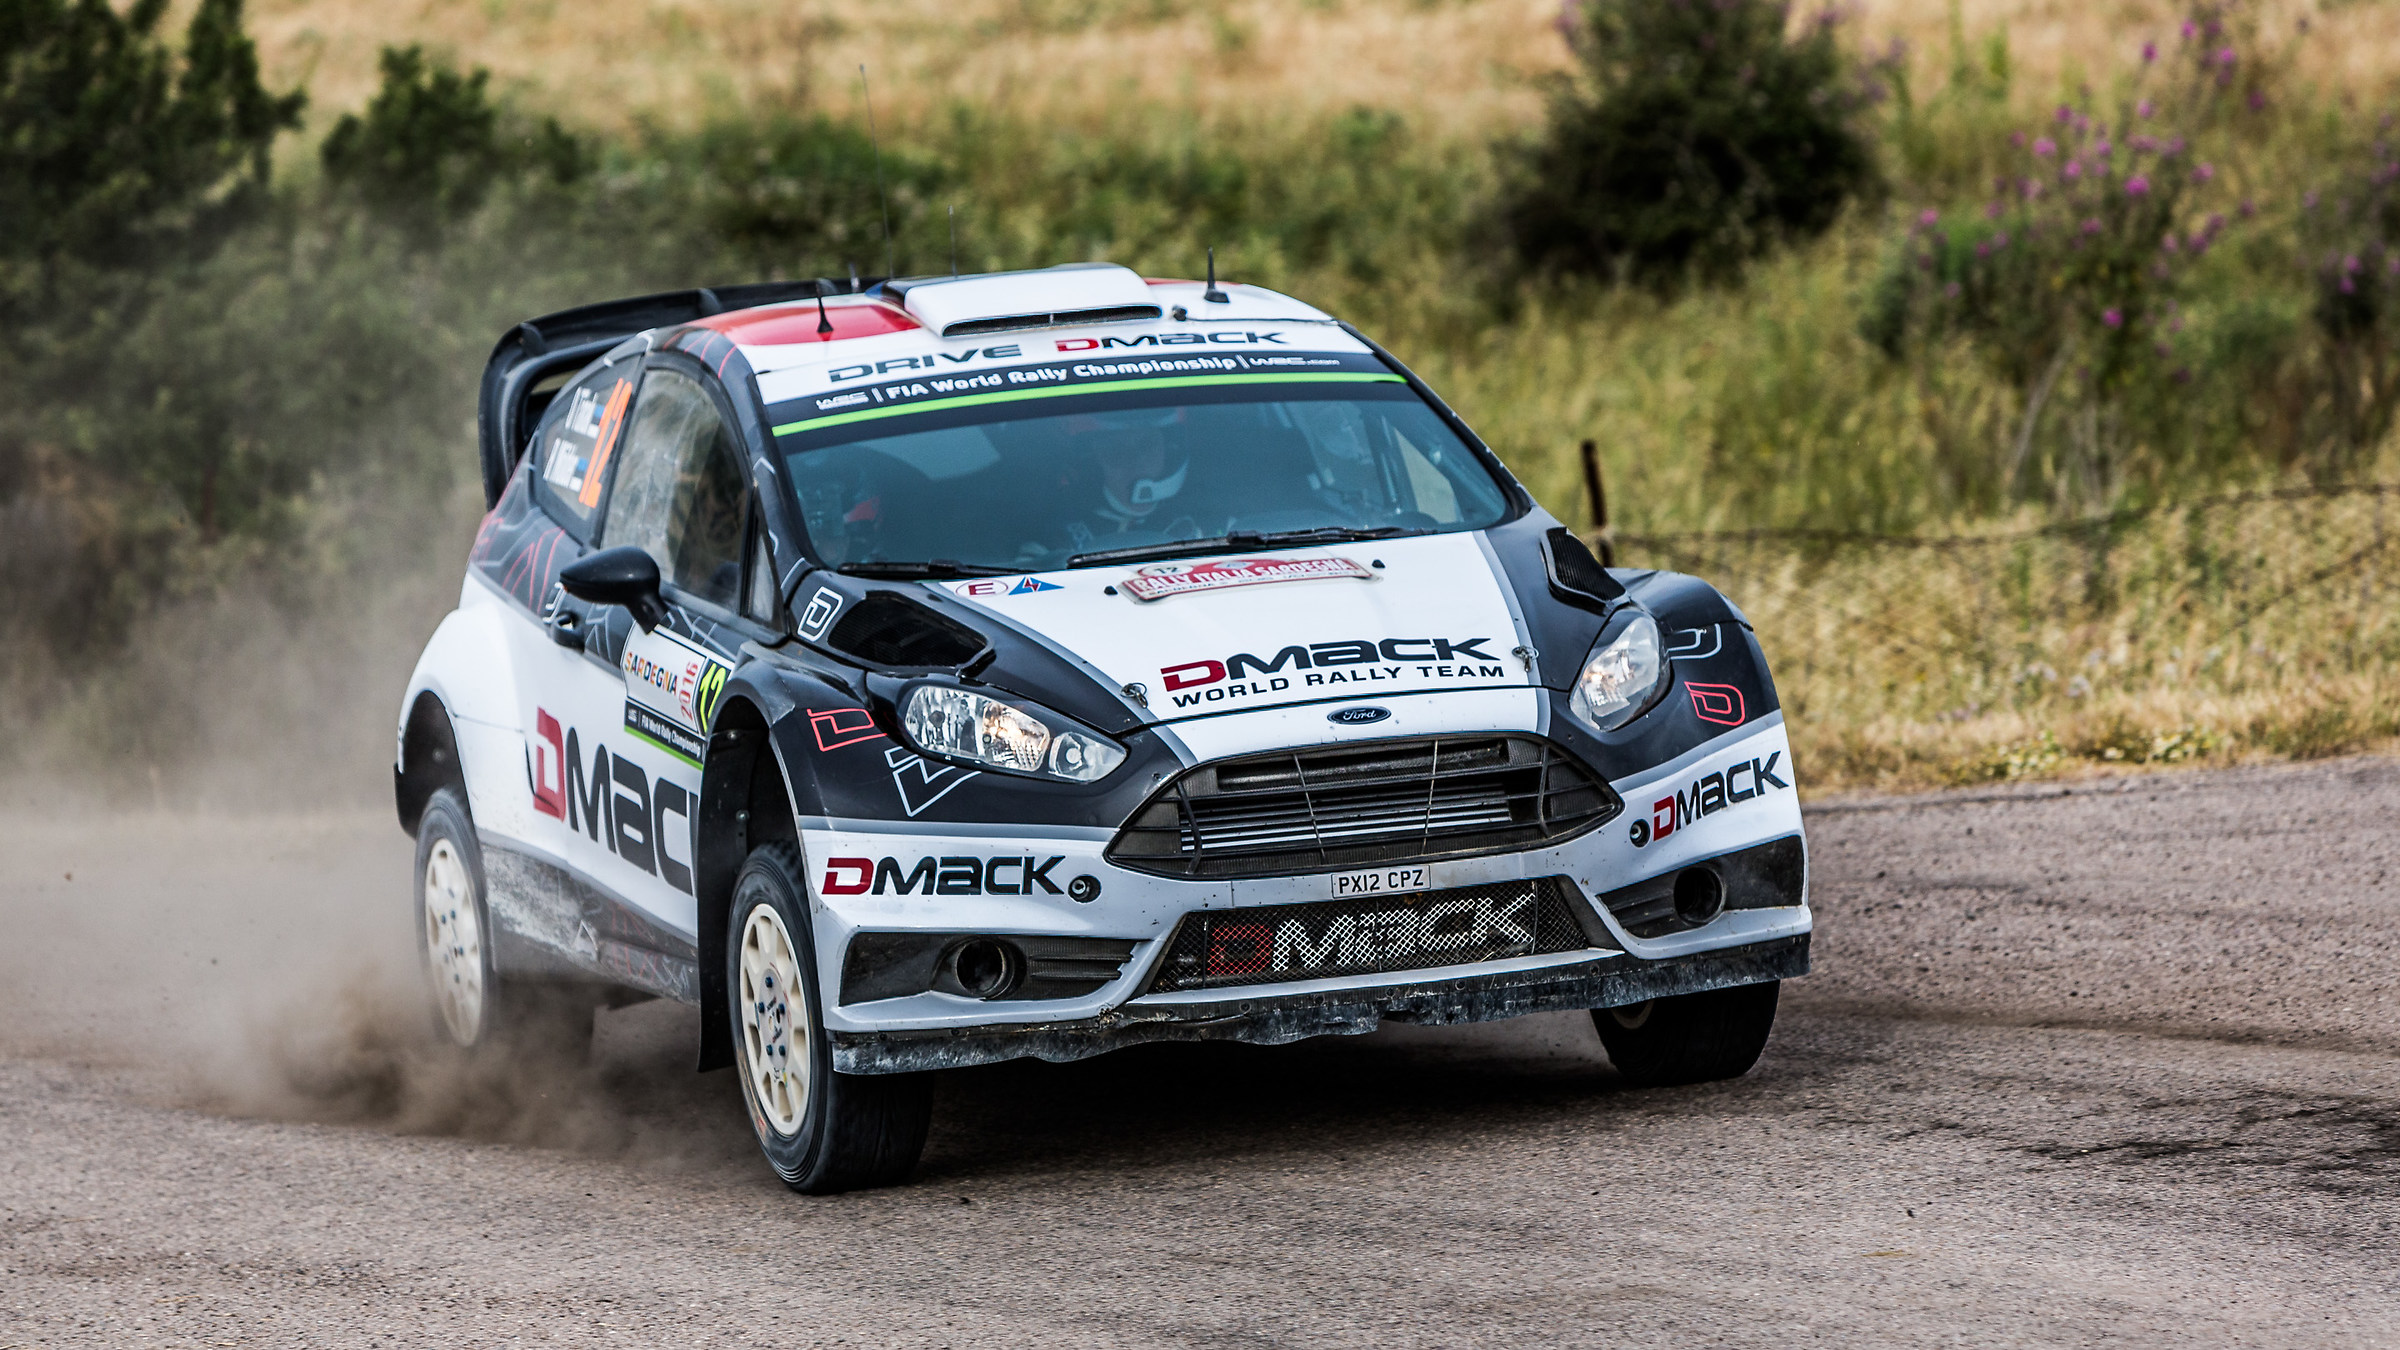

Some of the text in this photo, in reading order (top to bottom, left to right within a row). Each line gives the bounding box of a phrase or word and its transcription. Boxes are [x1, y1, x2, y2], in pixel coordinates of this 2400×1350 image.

[828, 344, 1022, 382] DRIVE
[885, 383, 929, 400] FIA
[930, 373, 1003, 392] World
[1007, 366, 1067, 385] Rally
[1073, 355, 1237, 378] Championship
[1133, 574, 1194, 592] RALLY
[1194, 567, 1256, 584] ITALIA
[1255, 558, 1356, 578] SARDEGNA
[624, 652, 678, 696] SARDEGNA
[679, 661, 698, 721] 2016
[1172, 665, 1504, 709] WORLD RALLY TEAM
[1342, 708, 1377, 721] Ford
[1338, 869, 1424, 894] PX12 CPZ
